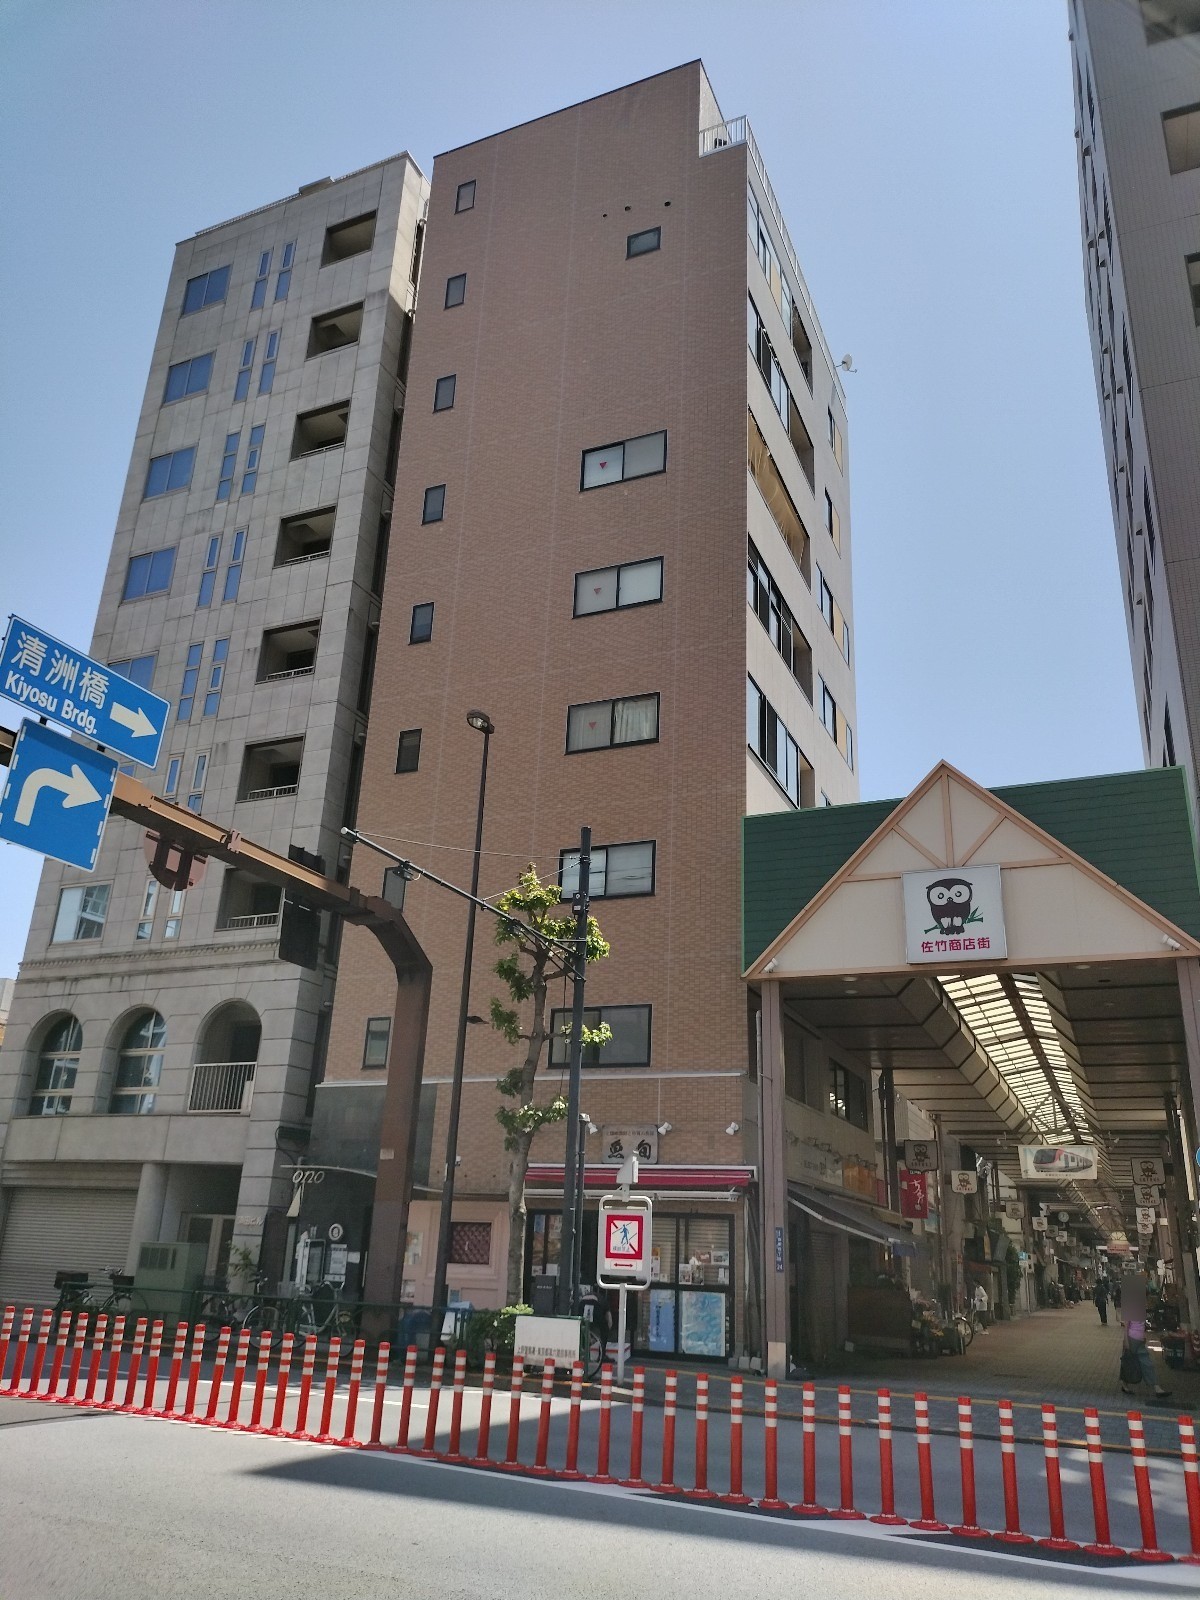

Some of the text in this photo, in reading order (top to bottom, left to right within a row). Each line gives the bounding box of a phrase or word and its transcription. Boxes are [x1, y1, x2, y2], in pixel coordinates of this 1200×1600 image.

[11, 631, 110, 709] 清洲橋
[5, 670, 97, 734] Kiyosu Brdg.
[920, 937, 991, 954] 佐竹商店街
[292, 1169, 326, 1184] ono
